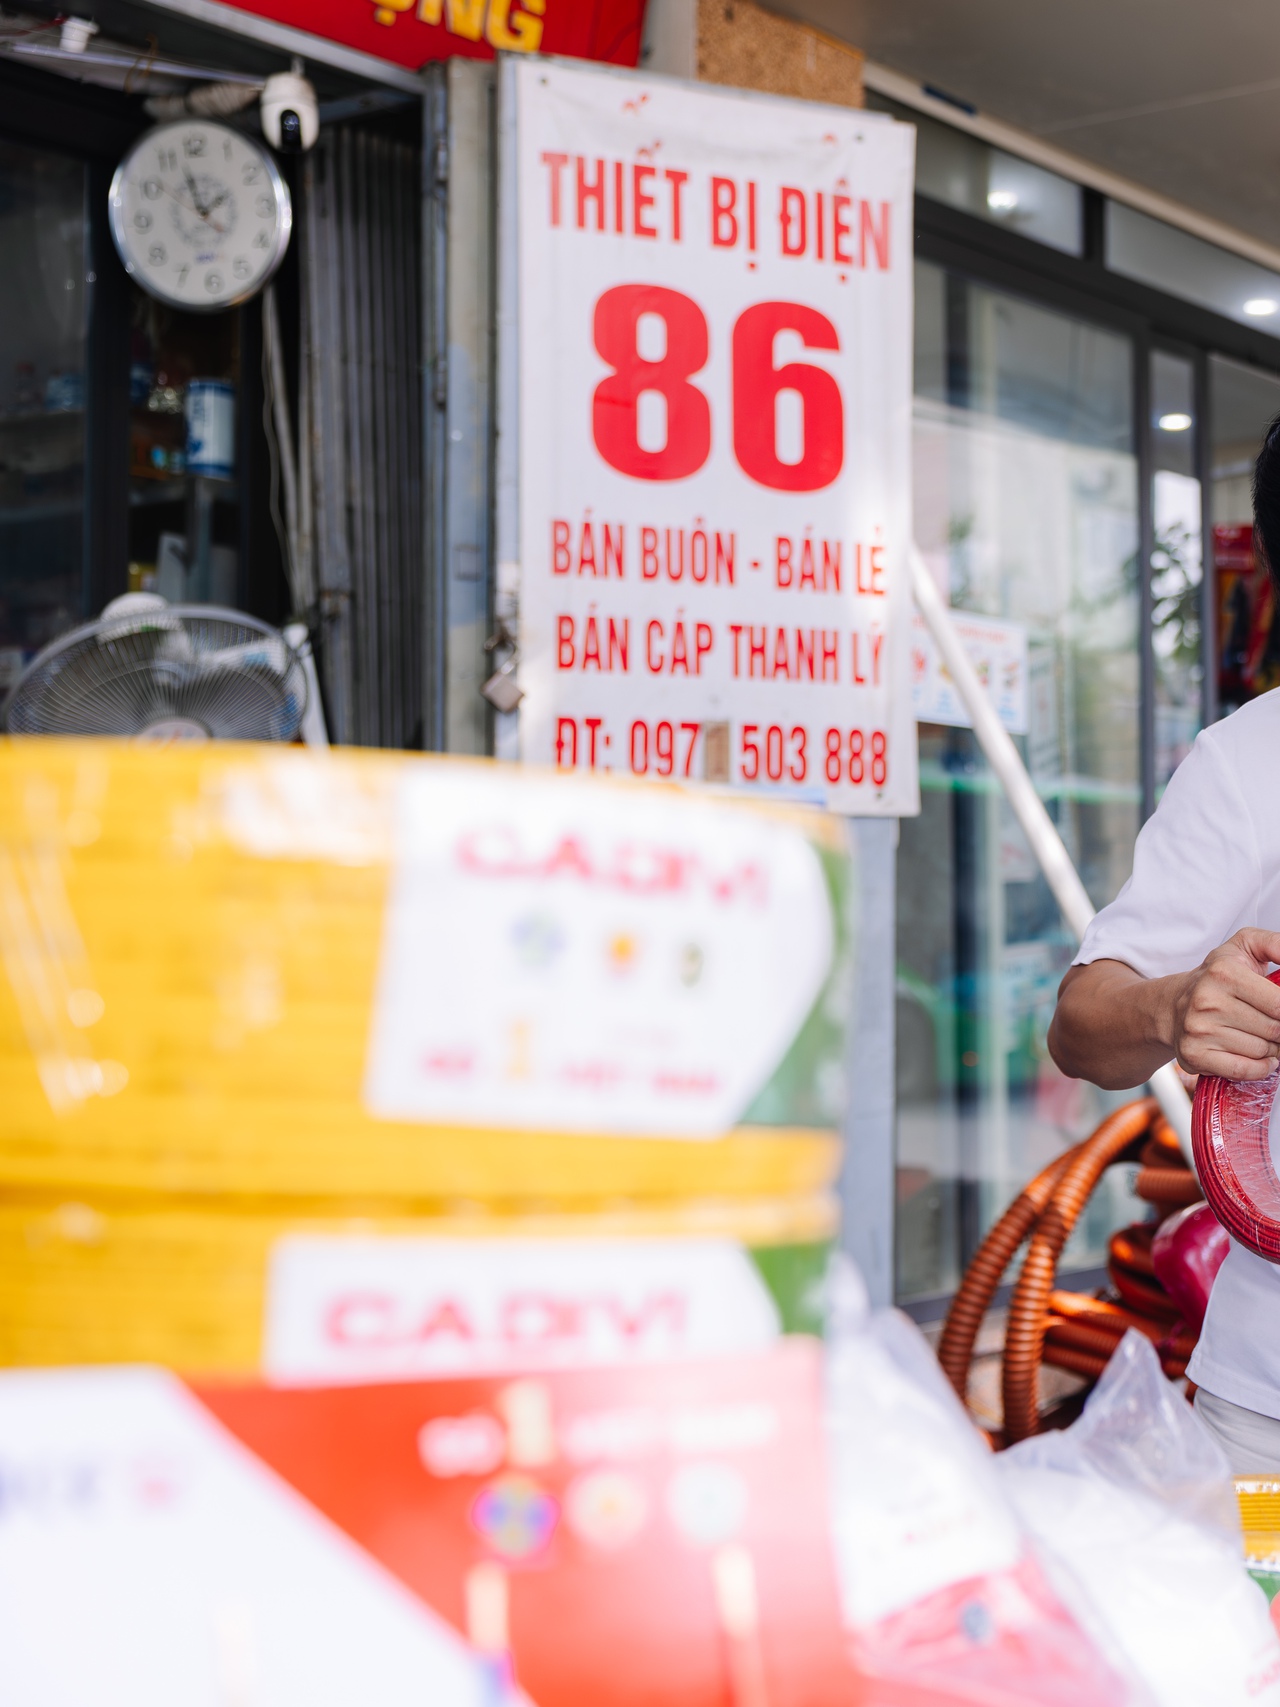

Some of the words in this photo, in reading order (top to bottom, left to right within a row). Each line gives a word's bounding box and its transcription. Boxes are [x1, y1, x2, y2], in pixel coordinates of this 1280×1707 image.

[538, 140, 689, 243] THIẾT
[711, 174, 757, 269] BỊ
[780, 176, 890, 284] ĐIỆN
[591, 282, 845, 494] 86
[552, 506, 624, 579] BÁN
[640, 515, 736, 586] BUÔN
[775, 525, 842, 592] BÁN
[855, 525, 888, 596] LẺ
[556, 602, 629, 674] BÁN
[646, 607, 713, 676] CÁP
[729, 624, 839, 683] THANH
[852, 622, 884, 686] LÝ
[554, 717, 611, 776] ĐT:
[630, 719, 728, 780] 097
[740, 724, 808, 784] 503
[824, 728, 888, 786] 888
